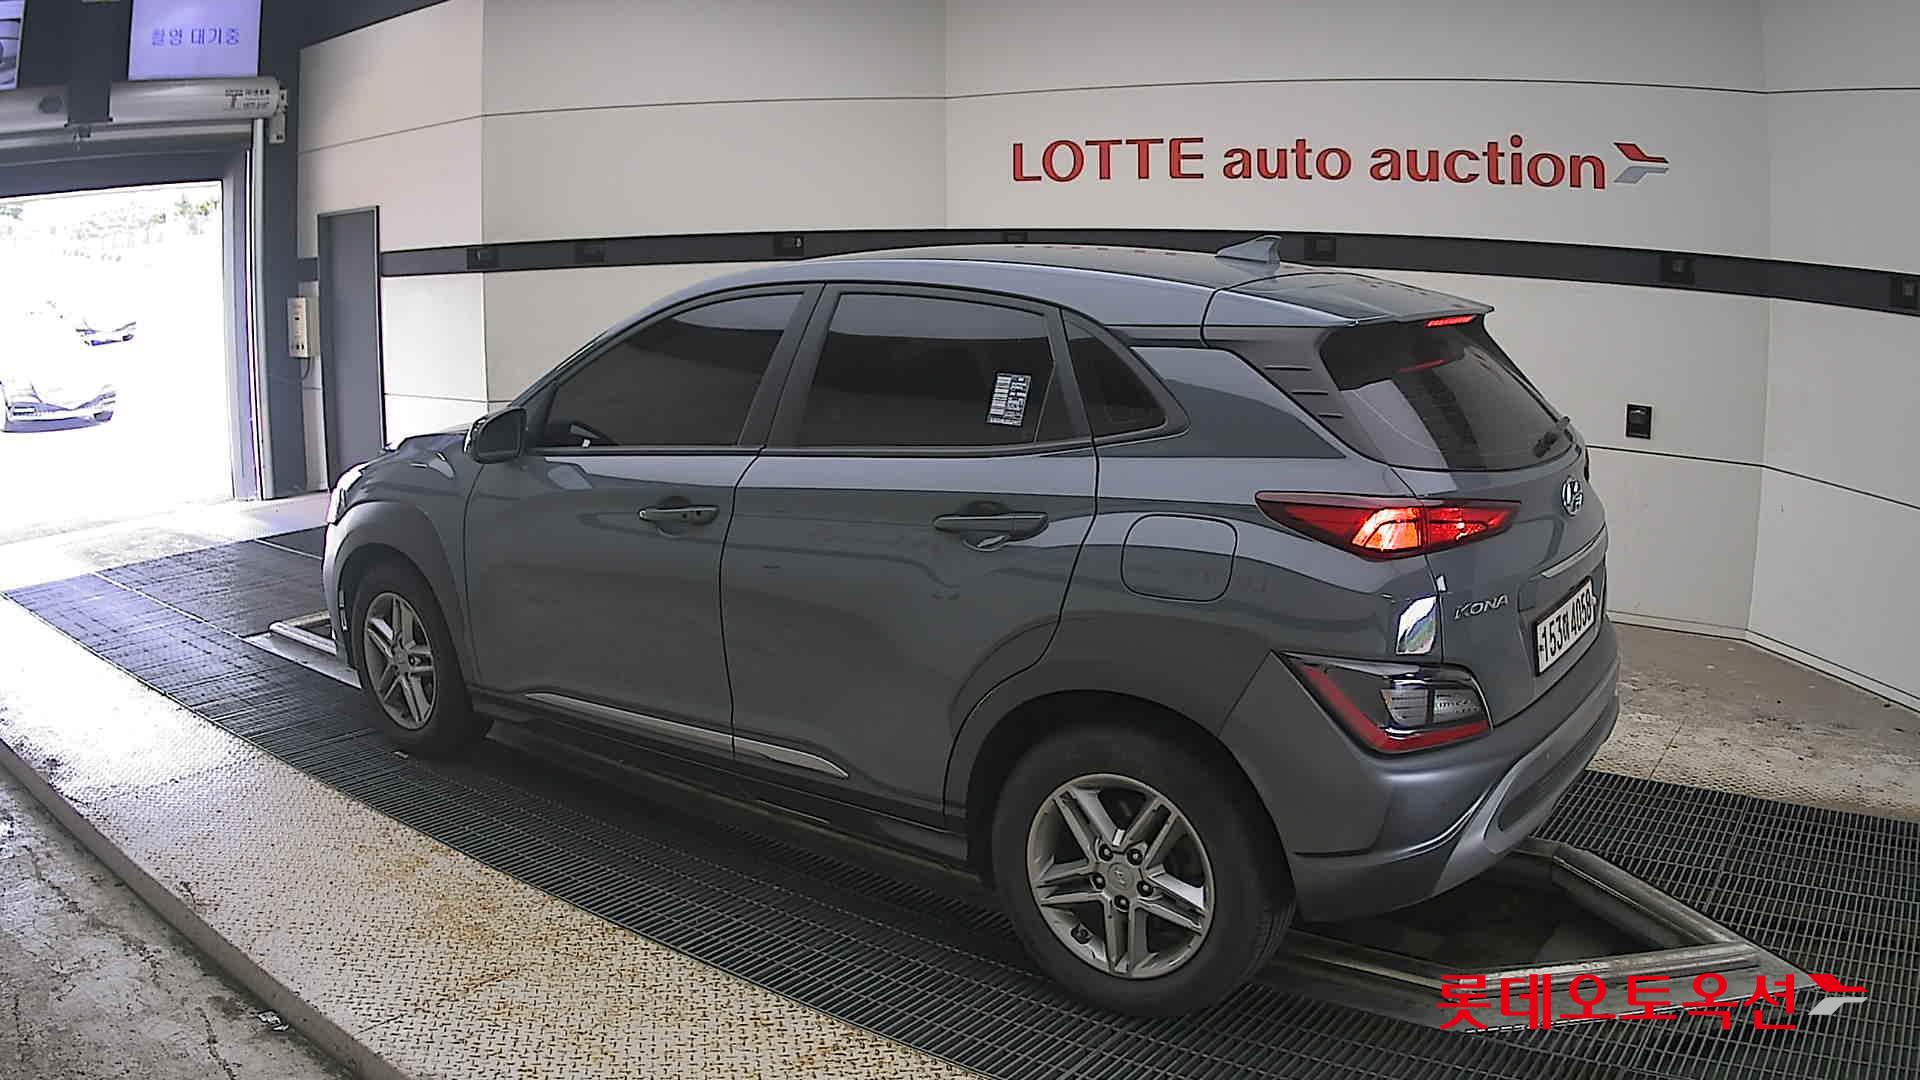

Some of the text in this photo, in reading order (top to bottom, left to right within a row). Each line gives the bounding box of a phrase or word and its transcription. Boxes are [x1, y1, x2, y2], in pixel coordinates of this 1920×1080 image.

[191, 27, 240, 46] 대기중
[1012, 134, 1606, 189] LOTTE auto auction
[1454, 593, 1509, 620] KONA
